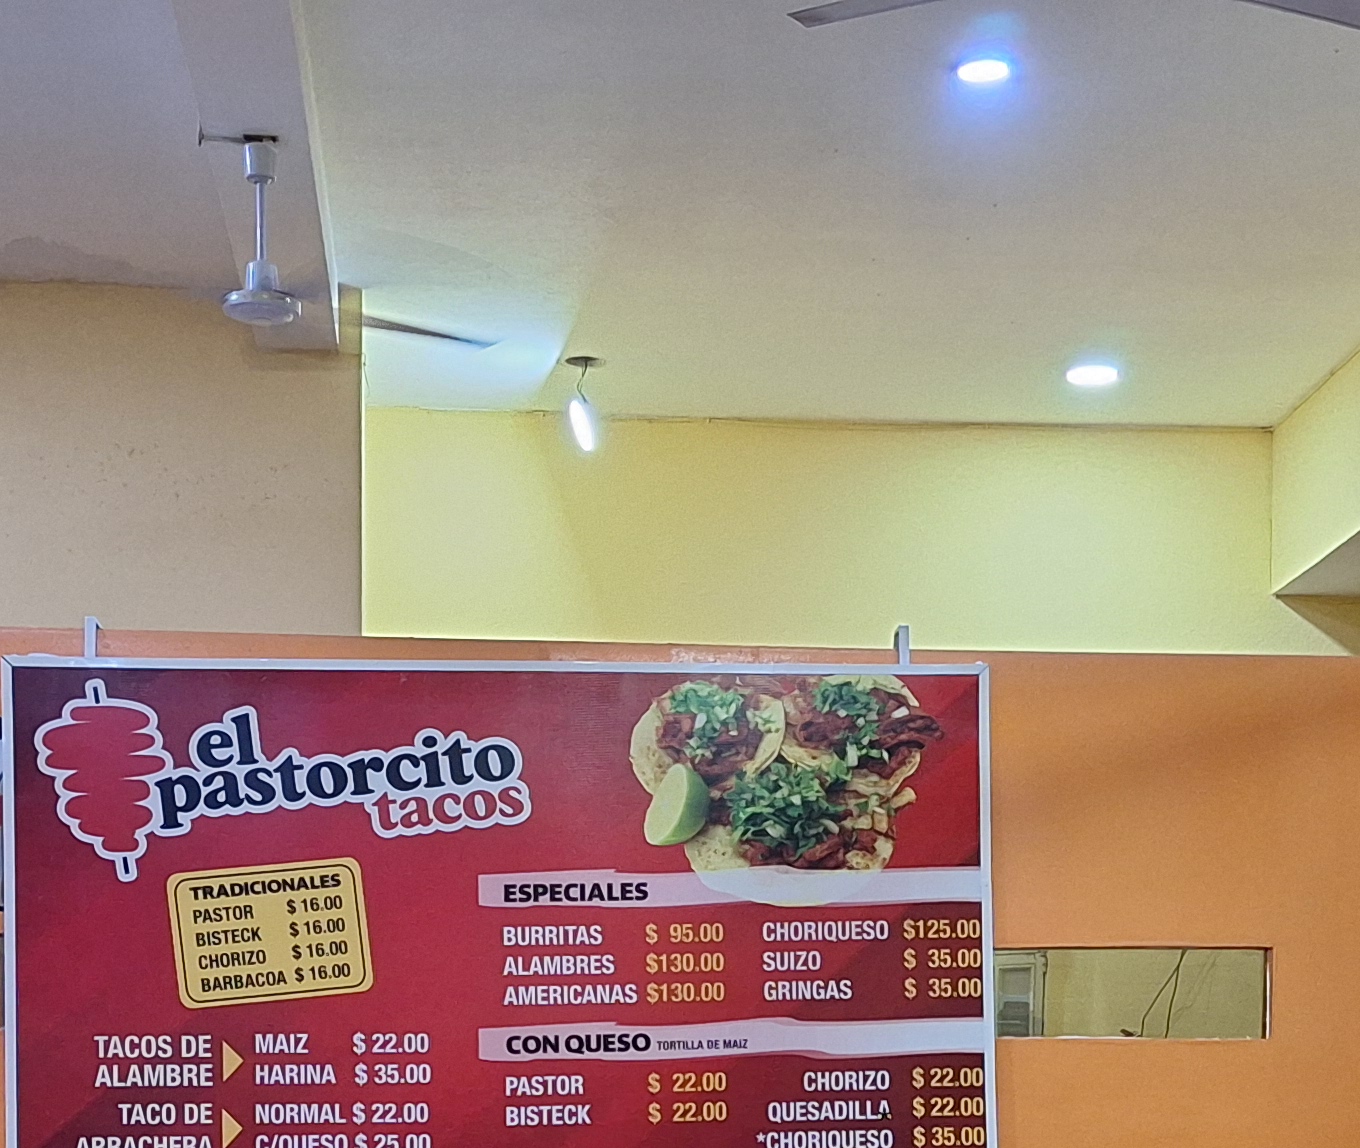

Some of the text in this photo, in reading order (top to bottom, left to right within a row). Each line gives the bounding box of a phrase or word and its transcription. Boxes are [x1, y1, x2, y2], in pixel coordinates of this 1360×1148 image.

[196, 711, 258, 769] el
[155, 735, 515, 830] pastorcito
[372, 785, 527, 830] tacos
[189, 873, 342, 901] TRADICIONALES
[503, 881, 649, 903] ESPECIALES
[193, 895, 343, 925] PASTOR $ 16.00
[196, 917, 346, 947] BISTECK $ 16.00
[502, 922, 724, 946] BURRITAS $ 95.00
[762, 919, 981, 942] CHORIQUESO $125.00
[198, 940, 348, 970] CHORIZO $ 16.00
[503, 952, 725, 977] ALAMBRES $130.00
[762, 948, 982, 972] SUIZO $ 35.00
[201, 963, 351, 993] BARBACOA $ 16.00
[763, 977, 982, 1001] GRINGAS $ 35.00
[503, 982, 725, 1006] AMERICANAS $130.00
[94, 1035, 212, 1059] TACOS DE
[255, 1032, 429, 1056] MAIZ $ 22.00
[505, 1033, 749, 1056] CON QUESO TORTILLA DE MAIZ
[94, 1063, 214, 1088] ALAMBRE
[255, 1062, 432, 1086] HARINA $ 35.00
[505, 1072, 727, 1096] PASTOR $ 22.00
[803, 1067, 983, 1092] CHORIZO $ 22.00
[118, 1103, 213, 1126] TACO DE
[254, 1101, 429, 1126] NORMAL $ 22.00
[505, 1102, 728, 1127] BISTECK $ 22.00
[767, 1097, 984, 1124] QUESADILLA $ 22.00
[931, 1126, 985, 1147] 35.00
